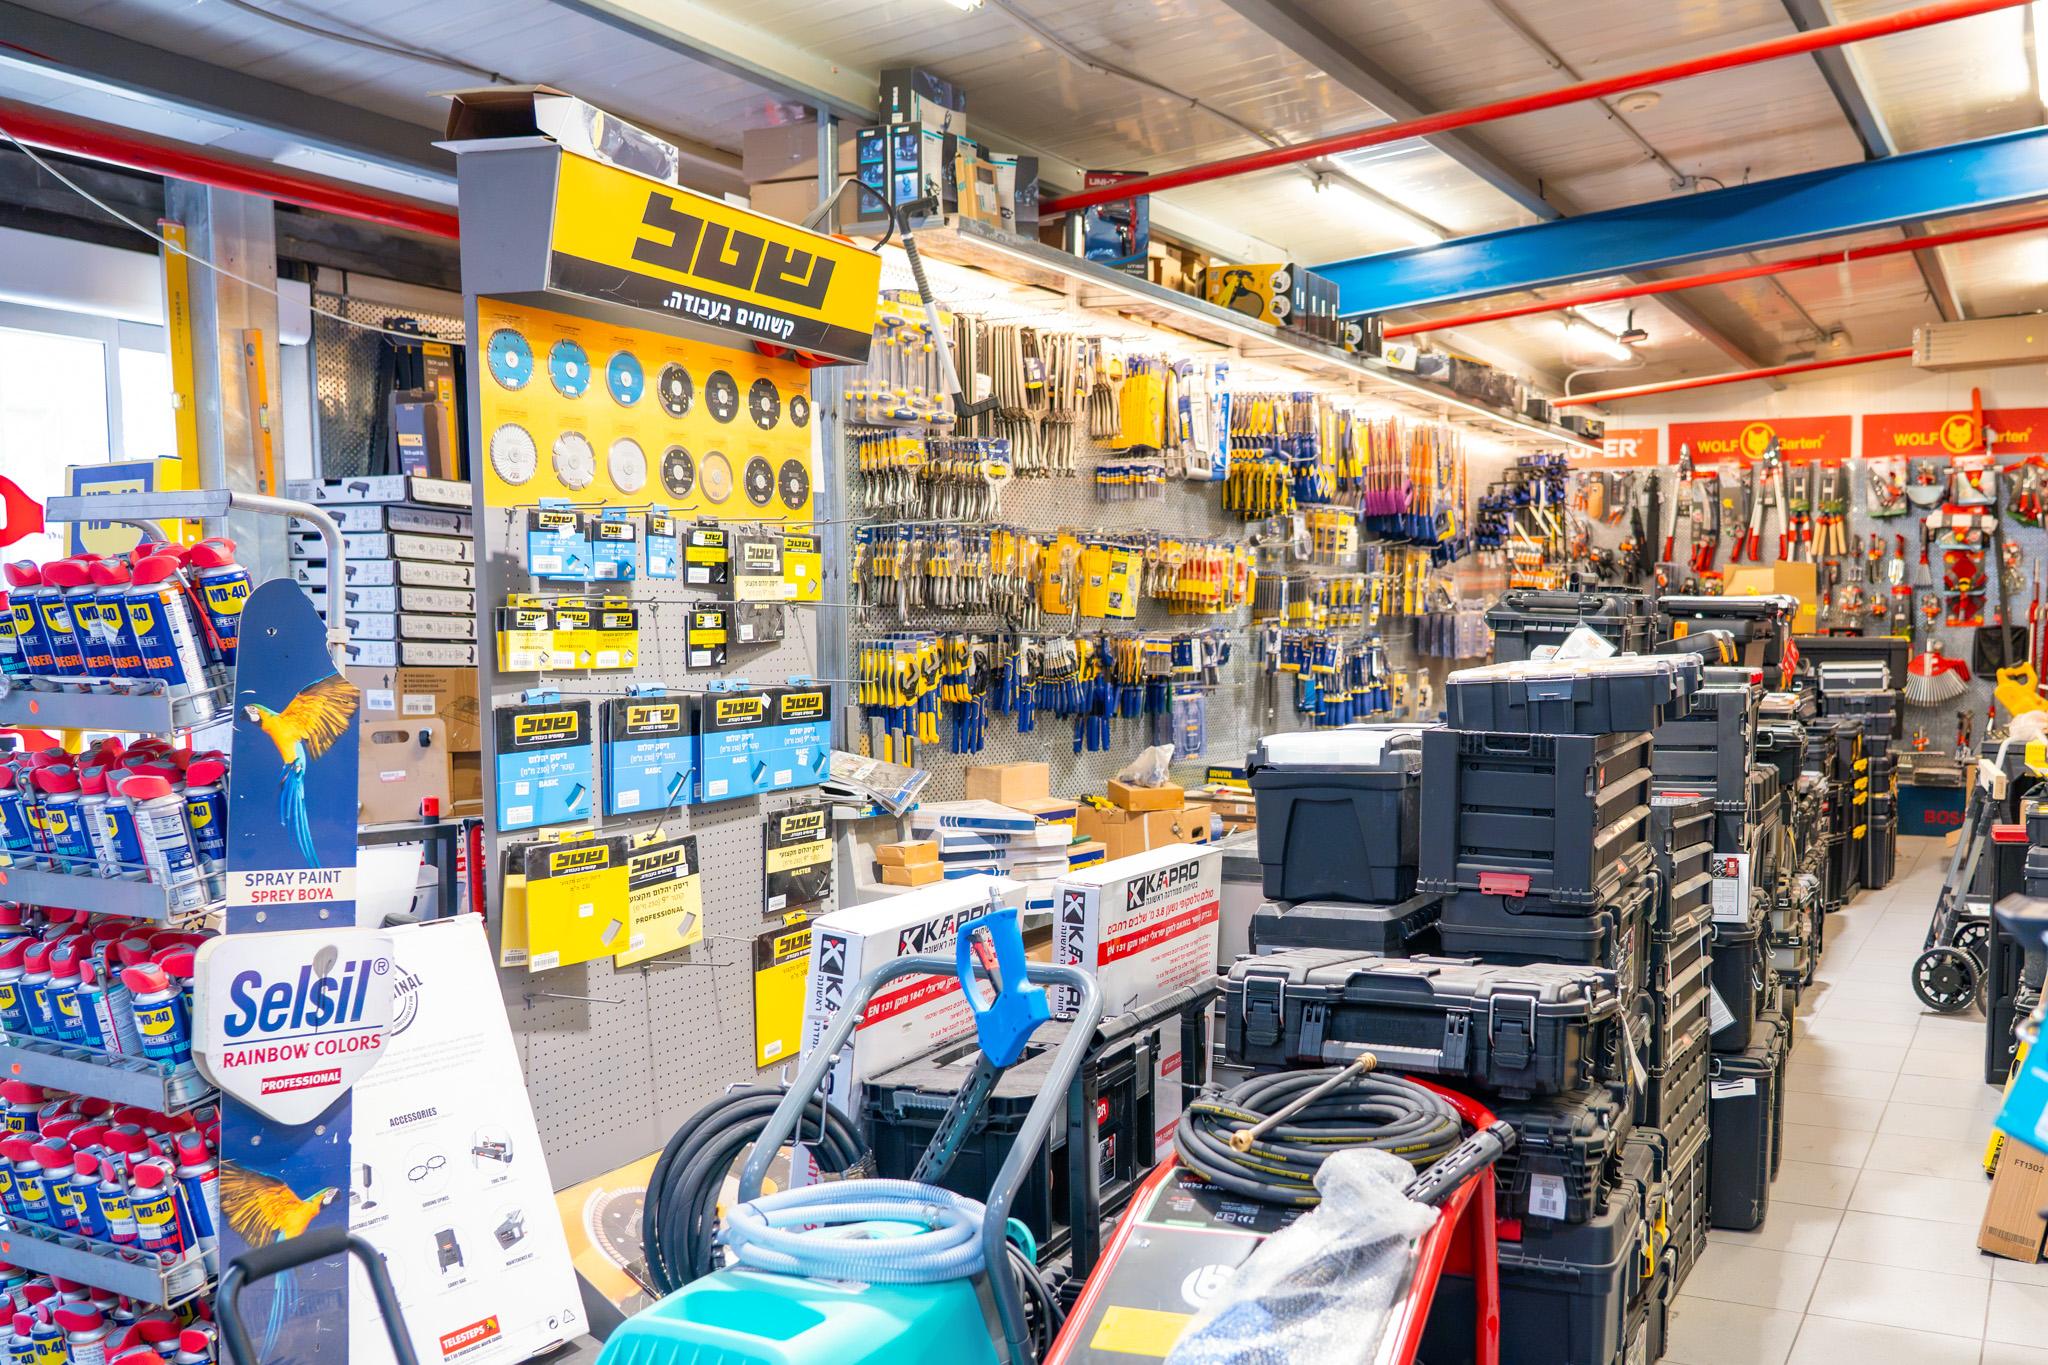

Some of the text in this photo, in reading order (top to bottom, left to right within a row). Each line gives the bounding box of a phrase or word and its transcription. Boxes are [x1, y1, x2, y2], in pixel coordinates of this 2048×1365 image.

[631, 191, 836, 310] שטל
[663, 291, 795, 340] קשוחים בעבודה.
[1697, 441, 1739, 454] WOLF
[1894, 432, 1938, 446] WOLF
[747, 550, 774, 560] שטל
[209, 584, 248, 602] WD-40
[722, 701, 759, 716] שטל
[786, 697, 819, 709] שטל
[521, 716, 573, 733] שטל
[633, 708, 676, 724] של
[1209, 769, 1232, 778] IRWIN
[785, 815, 821, 831] שטל
[556, 850, 604, 868] שטל
[632, 850, 680, 874] שטל
[245, 870, 342, 887] SPRAY PAINT
[1146, 860, 1199, 895] KAPRO
[251, 887, 334, 903] SPREY BOYA
[629, 881, 689, 903] דיסק יהלום מקצוע
[635, 906, 684, 924] PROFESSIONAL
[910, 988, 925, 1001] 1847
[925, 980, 946, 995] ישראלי
[867, 1003, 880, 1018] EN
[881, 1001, 894, 1013] 131
[223, 1033, 382, 1068] RAINBOW COLORS
[261, 1071, 341, 1092] PROFESSIONAL
[389, 1107, 438, 1128] ACCESSORIES
[2014, 1158, 2045, 1174] FT1302
[138, 1201, 169, 1218] WD-40
[442, 1325, 485, 1349] TELESTEPS
